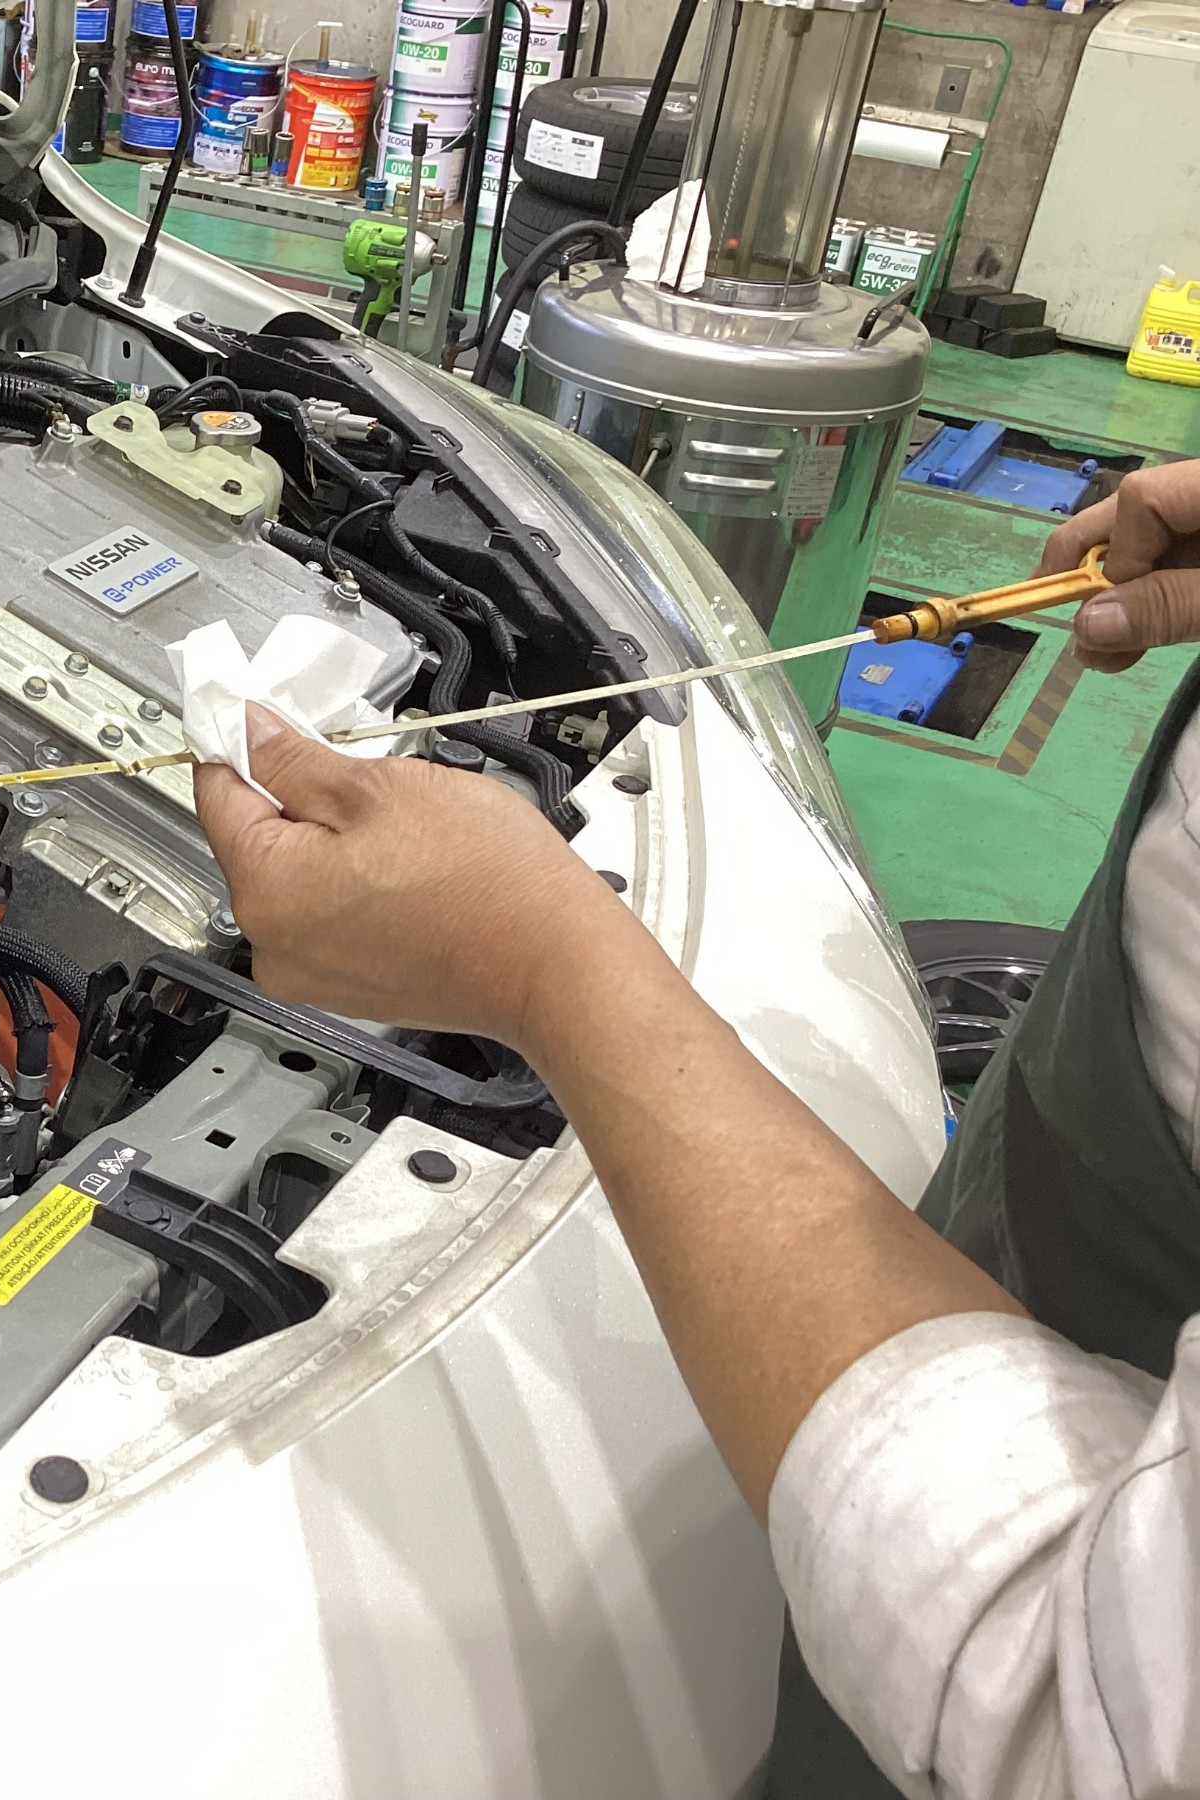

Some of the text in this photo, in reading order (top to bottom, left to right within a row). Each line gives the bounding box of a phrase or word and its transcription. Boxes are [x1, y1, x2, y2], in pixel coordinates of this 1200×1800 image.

[400, 16, 444, 30] ECOGUARD
[502, 31, 548, 46] COGARD
[402, 43, 440, 59] 0W-20
[135, 61, 159, 74] euro
[501, 58, 542, 75] 5W30
[391, 162, 430, 178] 0W-0
[867, 252, 891, 262] eco
[879, 260, 917, 274] green
[65, 534, 150, 581] NISSAN
